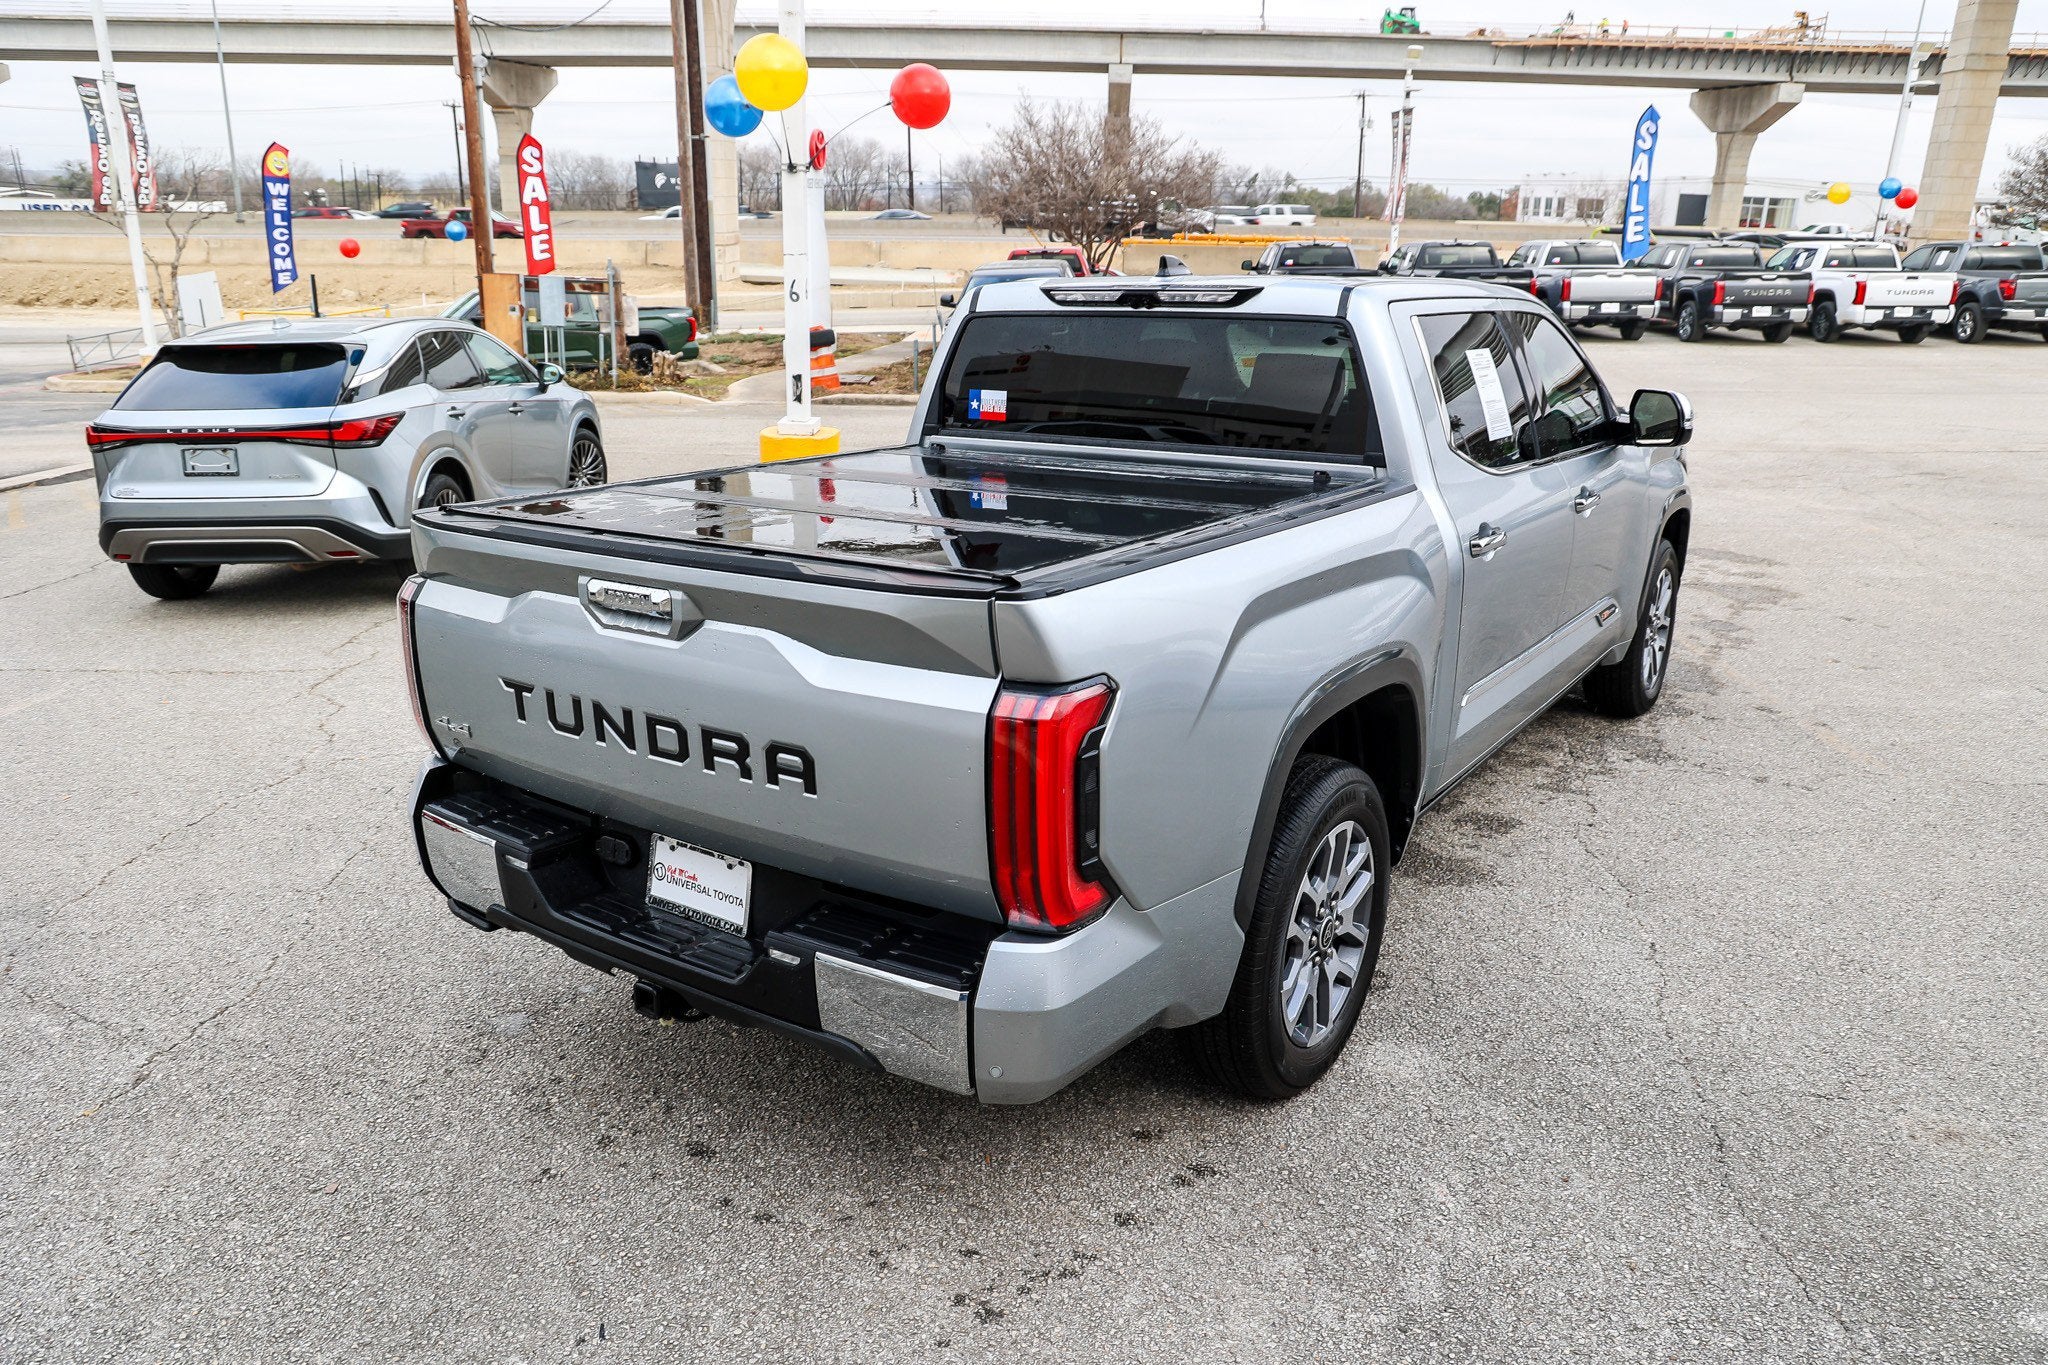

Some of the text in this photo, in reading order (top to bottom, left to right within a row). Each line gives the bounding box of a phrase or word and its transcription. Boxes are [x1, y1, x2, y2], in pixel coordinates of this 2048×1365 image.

[89, 109, 112, 205] Pre Owned
[127, 113, 148, 173] Owned
[138, 176, 150, 205] Pre
[1626, 119, 1657, 243] SALE
[266, 182, 293, 285] WELCOME
[521, 145, 551, 261] SALE
[498, 676, 818, 799] TUNDRA
[649, 895, 744, 936] UNIVERSALTOYOTA.COM
[666, 874, 744, 908] UNIVERSAL TOYOTA
